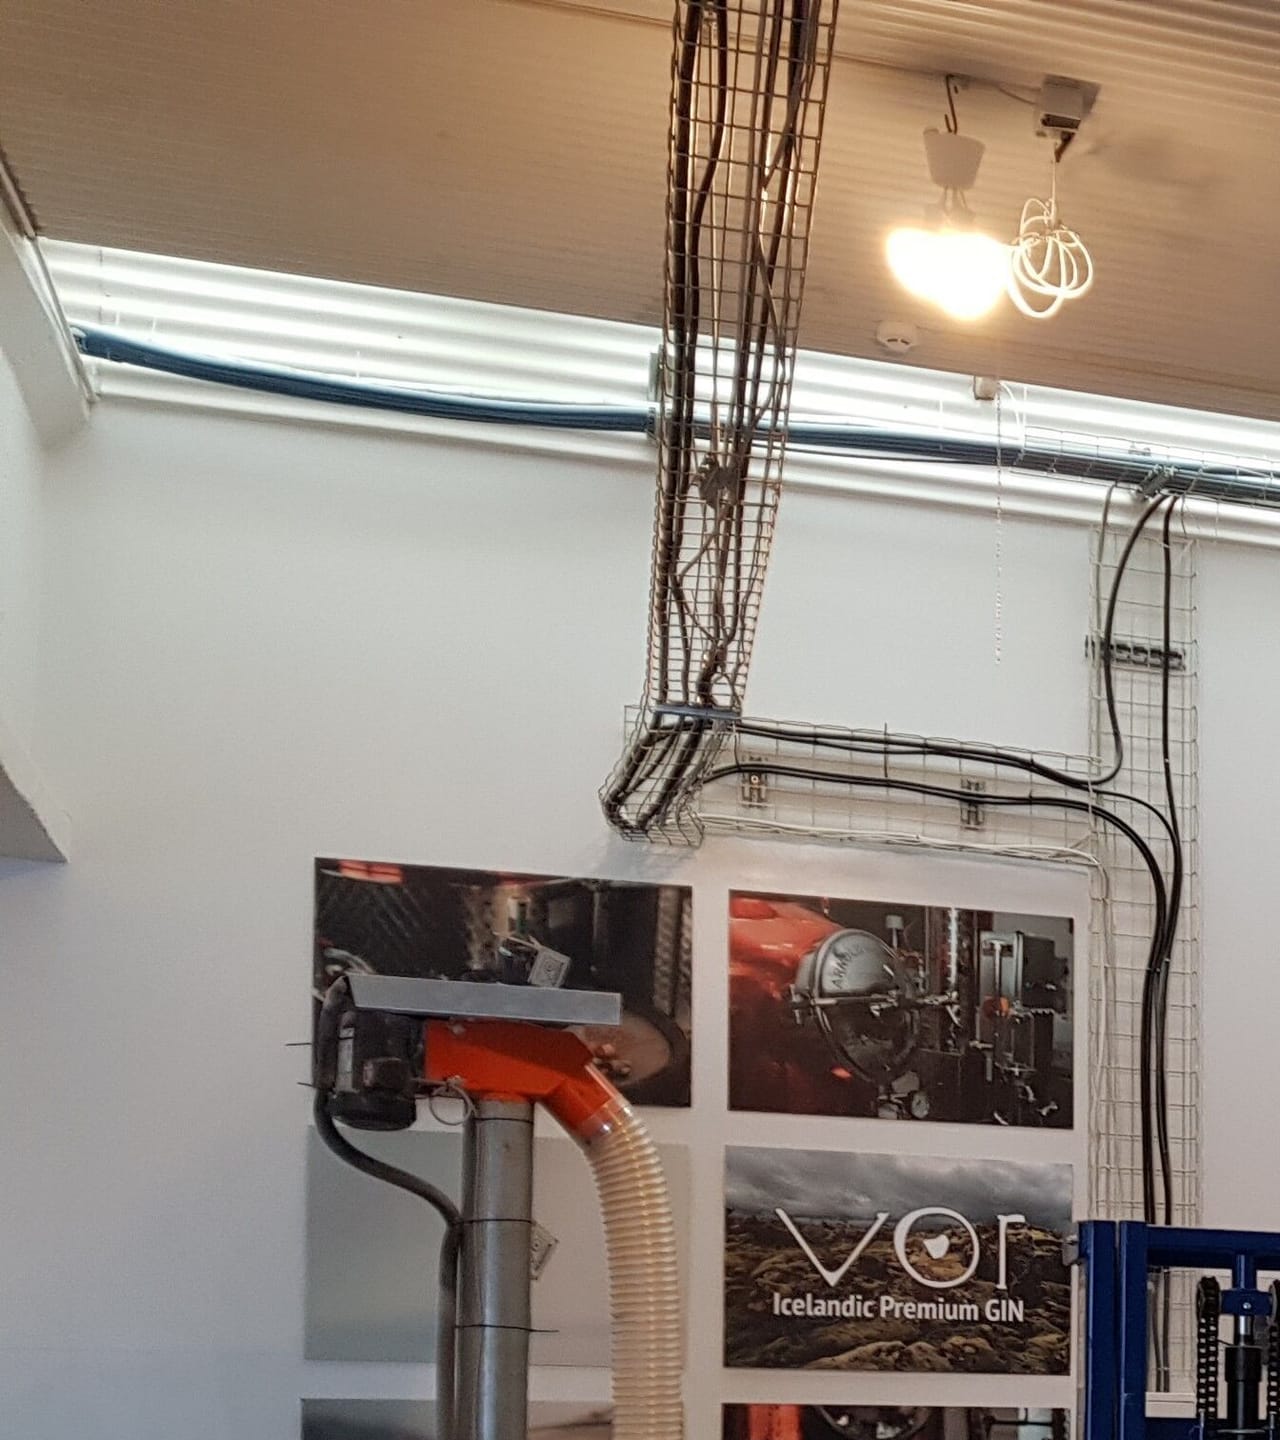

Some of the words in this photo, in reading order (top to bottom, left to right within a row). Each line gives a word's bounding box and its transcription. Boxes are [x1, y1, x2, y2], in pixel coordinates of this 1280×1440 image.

[772, 1291, 874, 1319] Icelandic
[879, 1295, 979, 1322] Premium
[985, 1299, 1024, 1322] GIN
